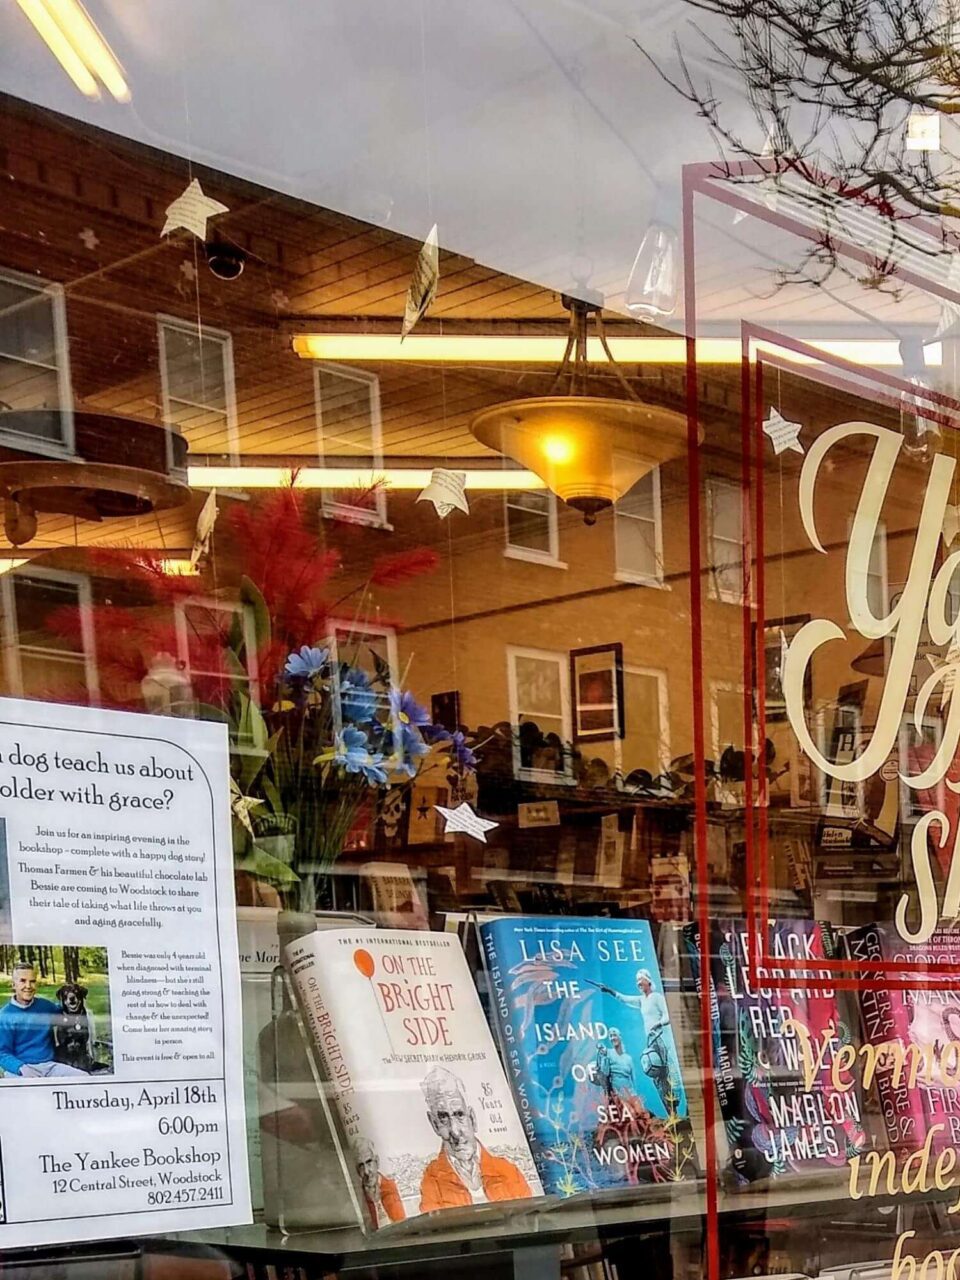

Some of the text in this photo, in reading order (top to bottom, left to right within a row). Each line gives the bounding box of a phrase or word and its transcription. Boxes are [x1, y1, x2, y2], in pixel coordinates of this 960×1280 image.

[9, 743, 194, 781] dog teach us about
[0, 777, 174, 811] older with grace?
[19, 841, 166, 861] bookshop complete happy
[18, 862, 208, 882] Thomas Farmen his beautiful chocolate lab
[31, 880, 167, 896] Bessie coming Woodstock
[519, 939, 646, 962] LISA SEE
[382, 955, 437, 976] ON THE
[543, 980, 581, 999] THE
[403, 1016, 453, 1047] SIDE
[485, 933, 537, 1143] THE ISLAND OF SEA WOMEN
[535, 1022, 609, 1043] ISLAND
[572, 1065, 598, 1083] OF
[53, 1086, 217, 1111] Thursday, April 18th
[769, 1091, 860, 1128] MARLON
[158, 1115, 218, 1137] 6:00pm
[597, 1104, 634, 1125] SEA
[593, 1142, 672, 1166] WOMEN
[764, 1126, 839, 1163] JAMES
[39, 1146, 221, 1173] The Yankee Bookshop
[53, 1169, 222, 1193] 12 Central Street, Woodstock
